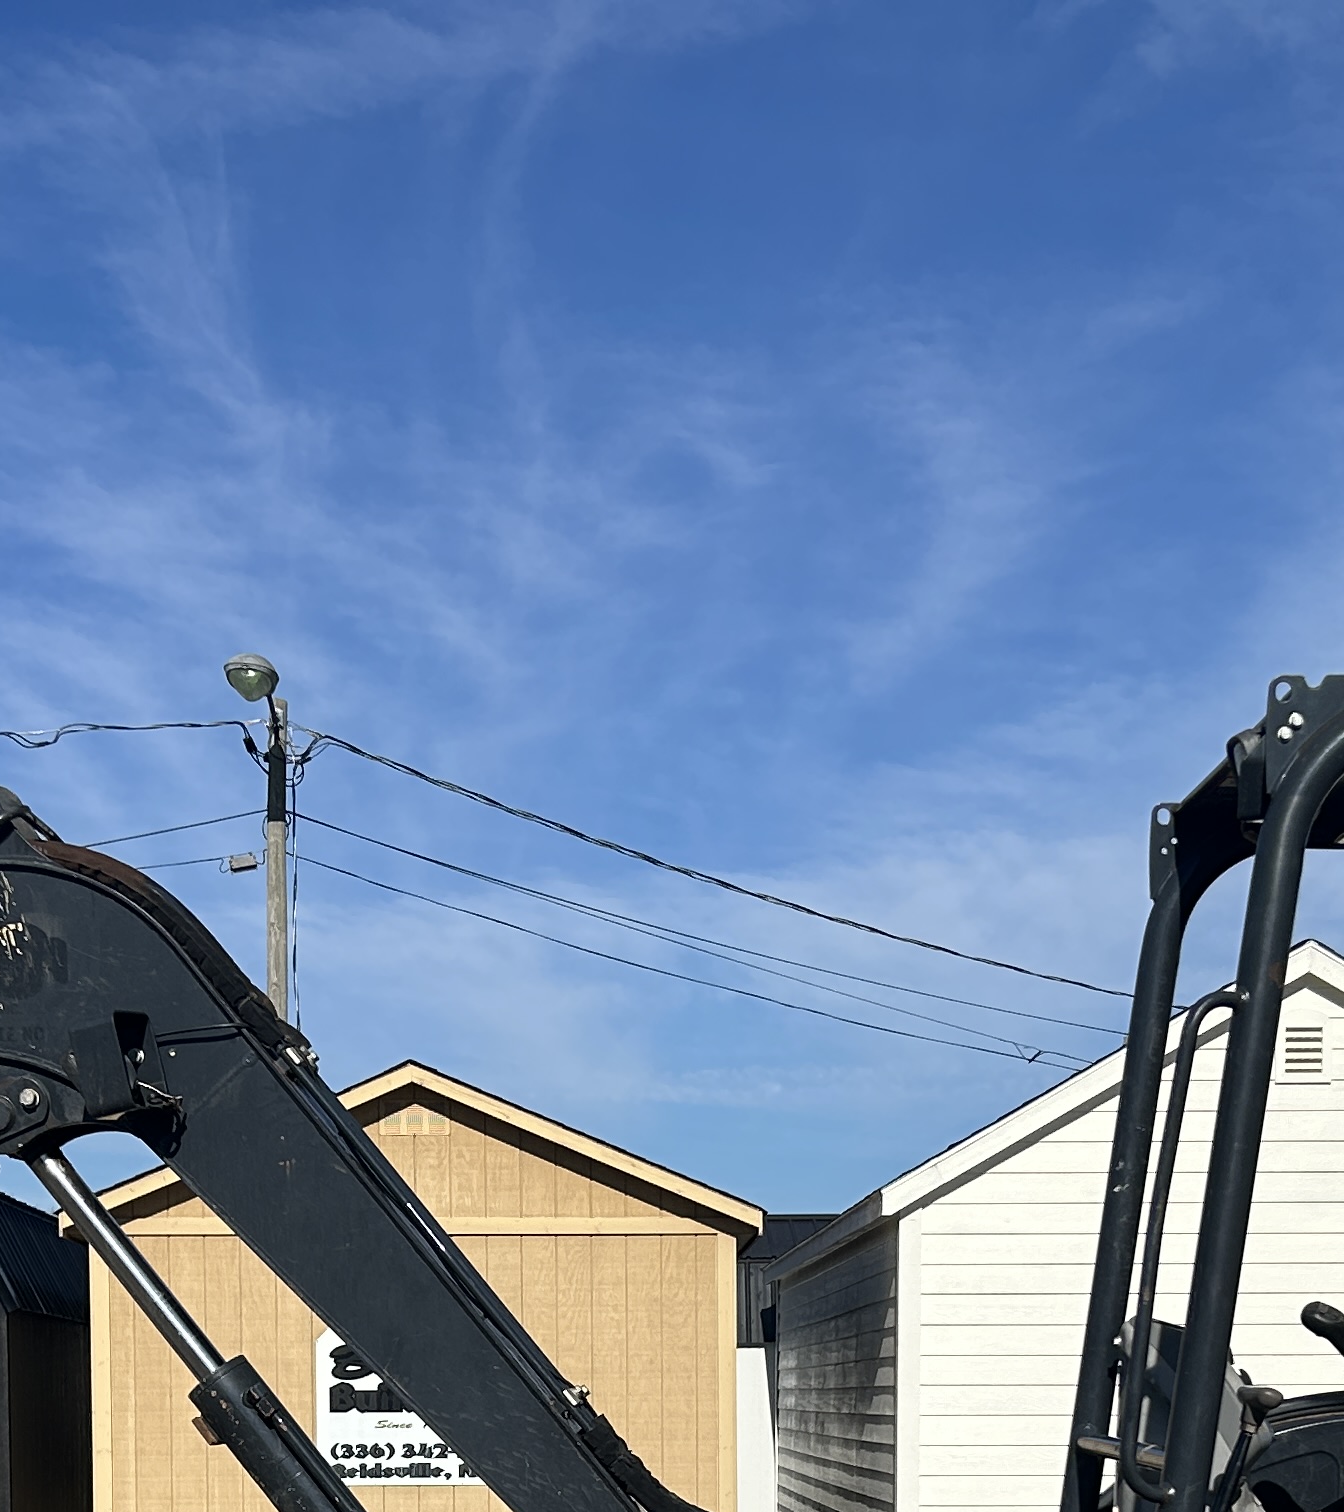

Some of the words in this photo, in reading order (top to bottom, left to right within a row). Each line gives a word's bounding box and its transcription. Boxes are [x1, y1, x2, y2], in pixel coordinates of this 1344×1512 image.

[374, 1420, 413, 1429] Since
[330, 1443, 396, 1460] (336)
[401, 1443, 460, 1459] 342-
[458, 1463, 479, 1478] N
